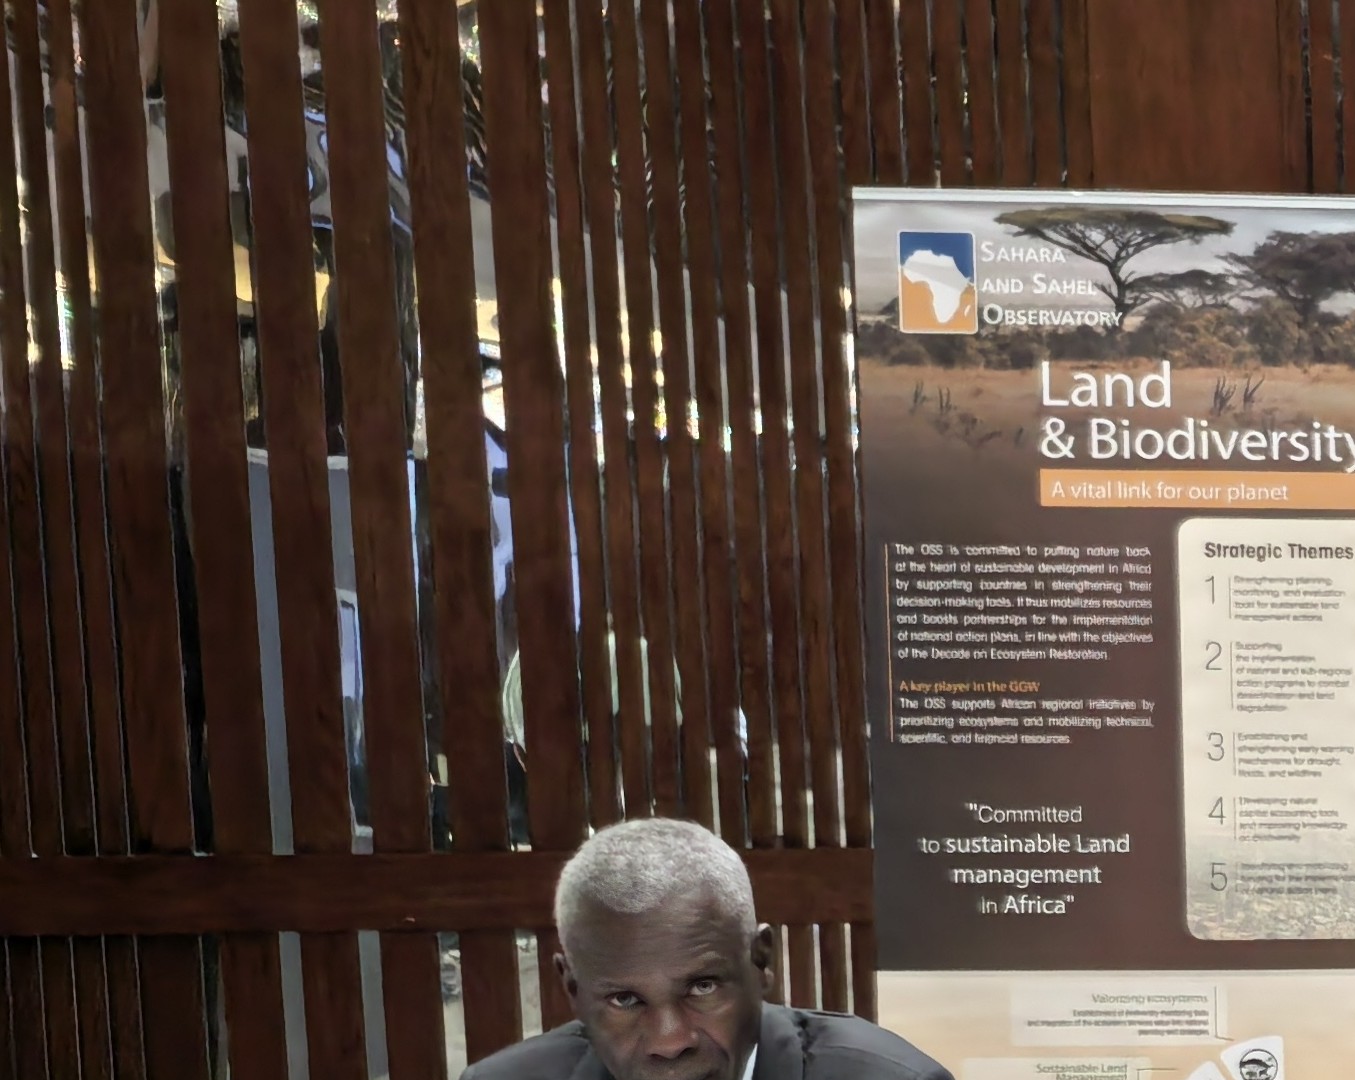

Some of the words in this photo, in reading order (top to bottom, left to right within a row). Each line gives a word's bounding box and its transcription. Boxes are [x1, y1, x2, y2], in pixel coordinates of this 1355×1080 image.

[1042, 360, 1171, 408] Land
[1041, 420, 1075, 459] &
[1051, 482, 1065, 497] A
[1070, 482, 1112, 498] vital
[1117, 482, 1152, 499] link
[1156, 483, 1183, 499] for
[1188, 486, 1223, 500] our
[1227, 484, 1289, 504] planet
[1204, 542, 1282, 562] Strategic
[1289, 543, 1354, 560] Themes
[1205, 576, 1215, 604] 1
[1205, 641, 1223, 670] 2
[1208, 732, 1225, 761] 3
[1208, 797, 1226, 825] 4
[921, 838, 940, 853] to
[946, 835, 1071, 853] sustainable
[1077, 835, 1130, 853] Land
[952, 866, 1102, 888] management
[1210, 863, 1227, 891] 5
[1004, 895, 1075, 914] Africa"
